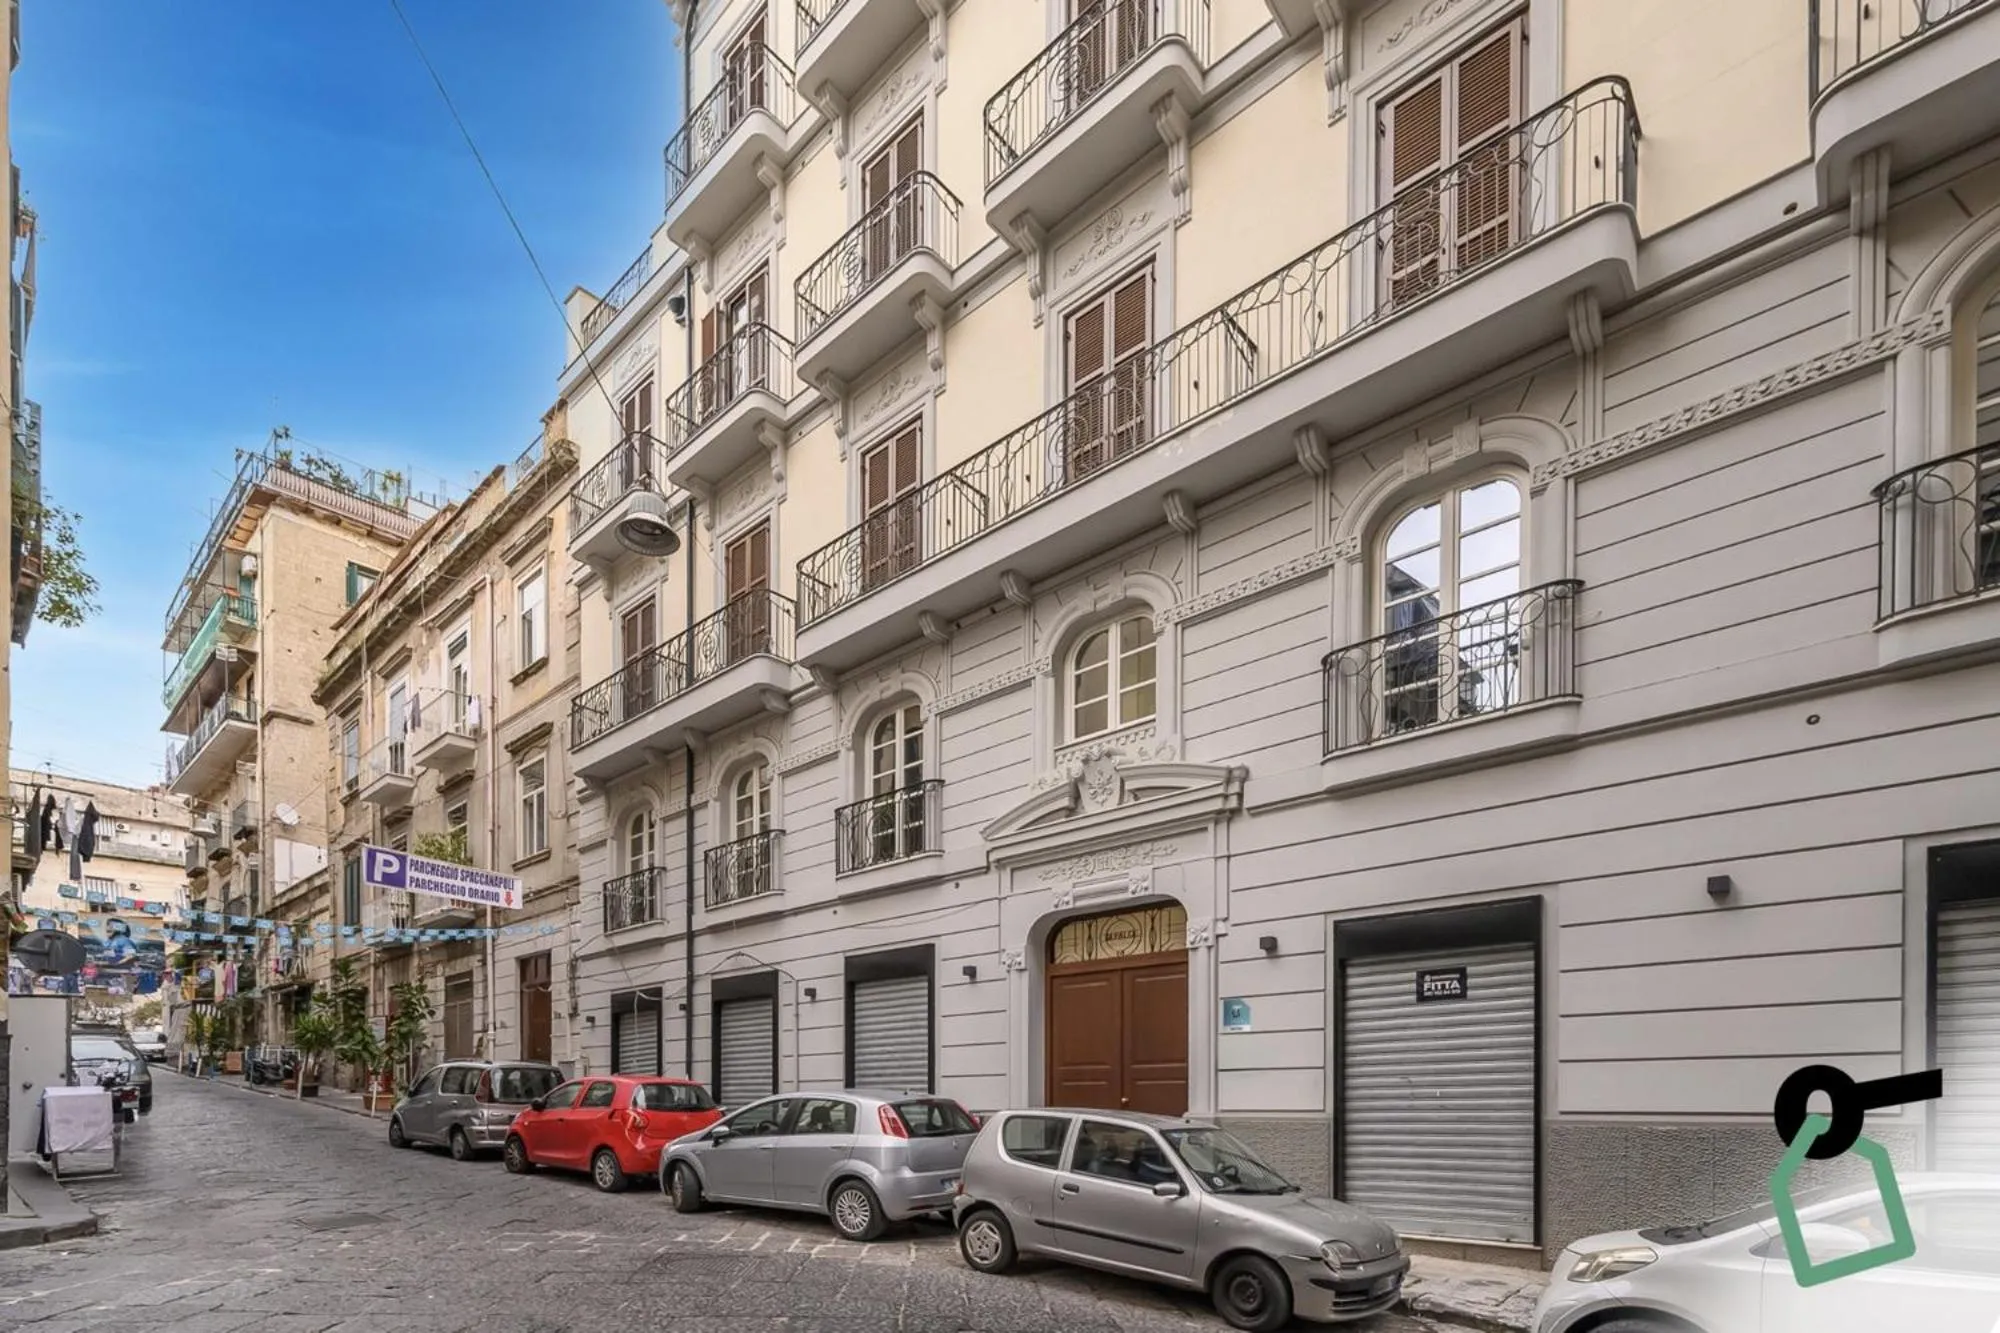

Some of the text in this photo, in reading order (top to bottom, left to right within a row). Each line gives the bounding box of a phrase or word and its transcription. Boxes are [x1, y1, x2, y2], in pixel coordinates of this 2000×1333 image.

[373, 852, 400, 882] P
[409, 858, 514, 891] PARCHEGGIO SPACCANAPOLI
[409, 876, 500, 903] PARCHEGGIO ORARIO
[1424, 980, 1460, 991] FITTA
